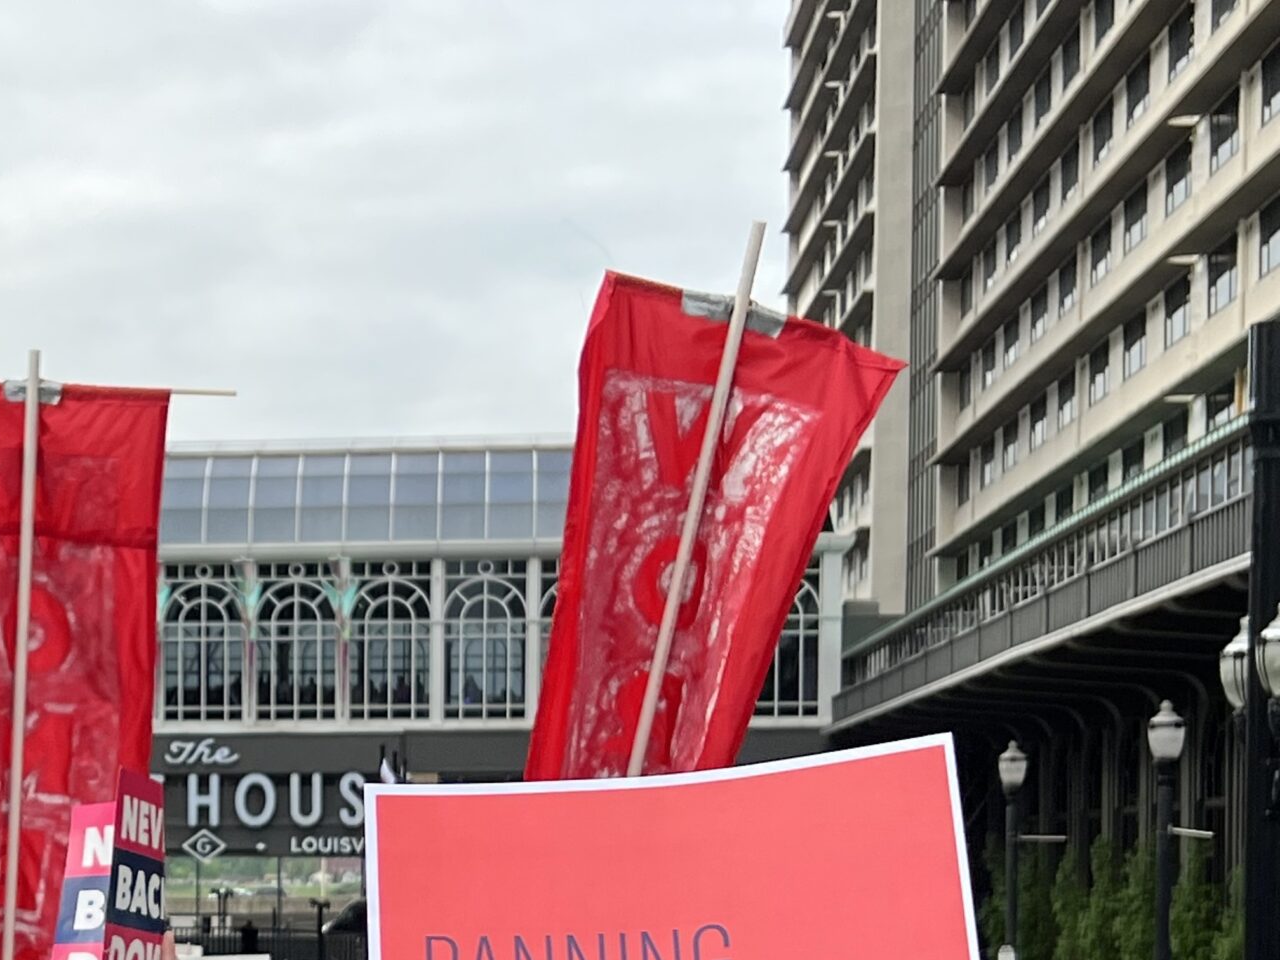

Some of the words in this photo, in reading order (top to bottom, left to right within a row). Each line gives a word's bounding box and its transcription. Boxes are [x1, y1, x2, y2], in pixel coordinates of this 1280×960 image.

[164, 738, 240, 764] The
[187, 772, 365, 827] HOUS
[121, 795, 165, 852] NEV
[290, 836, 365, 853] LOUISV
